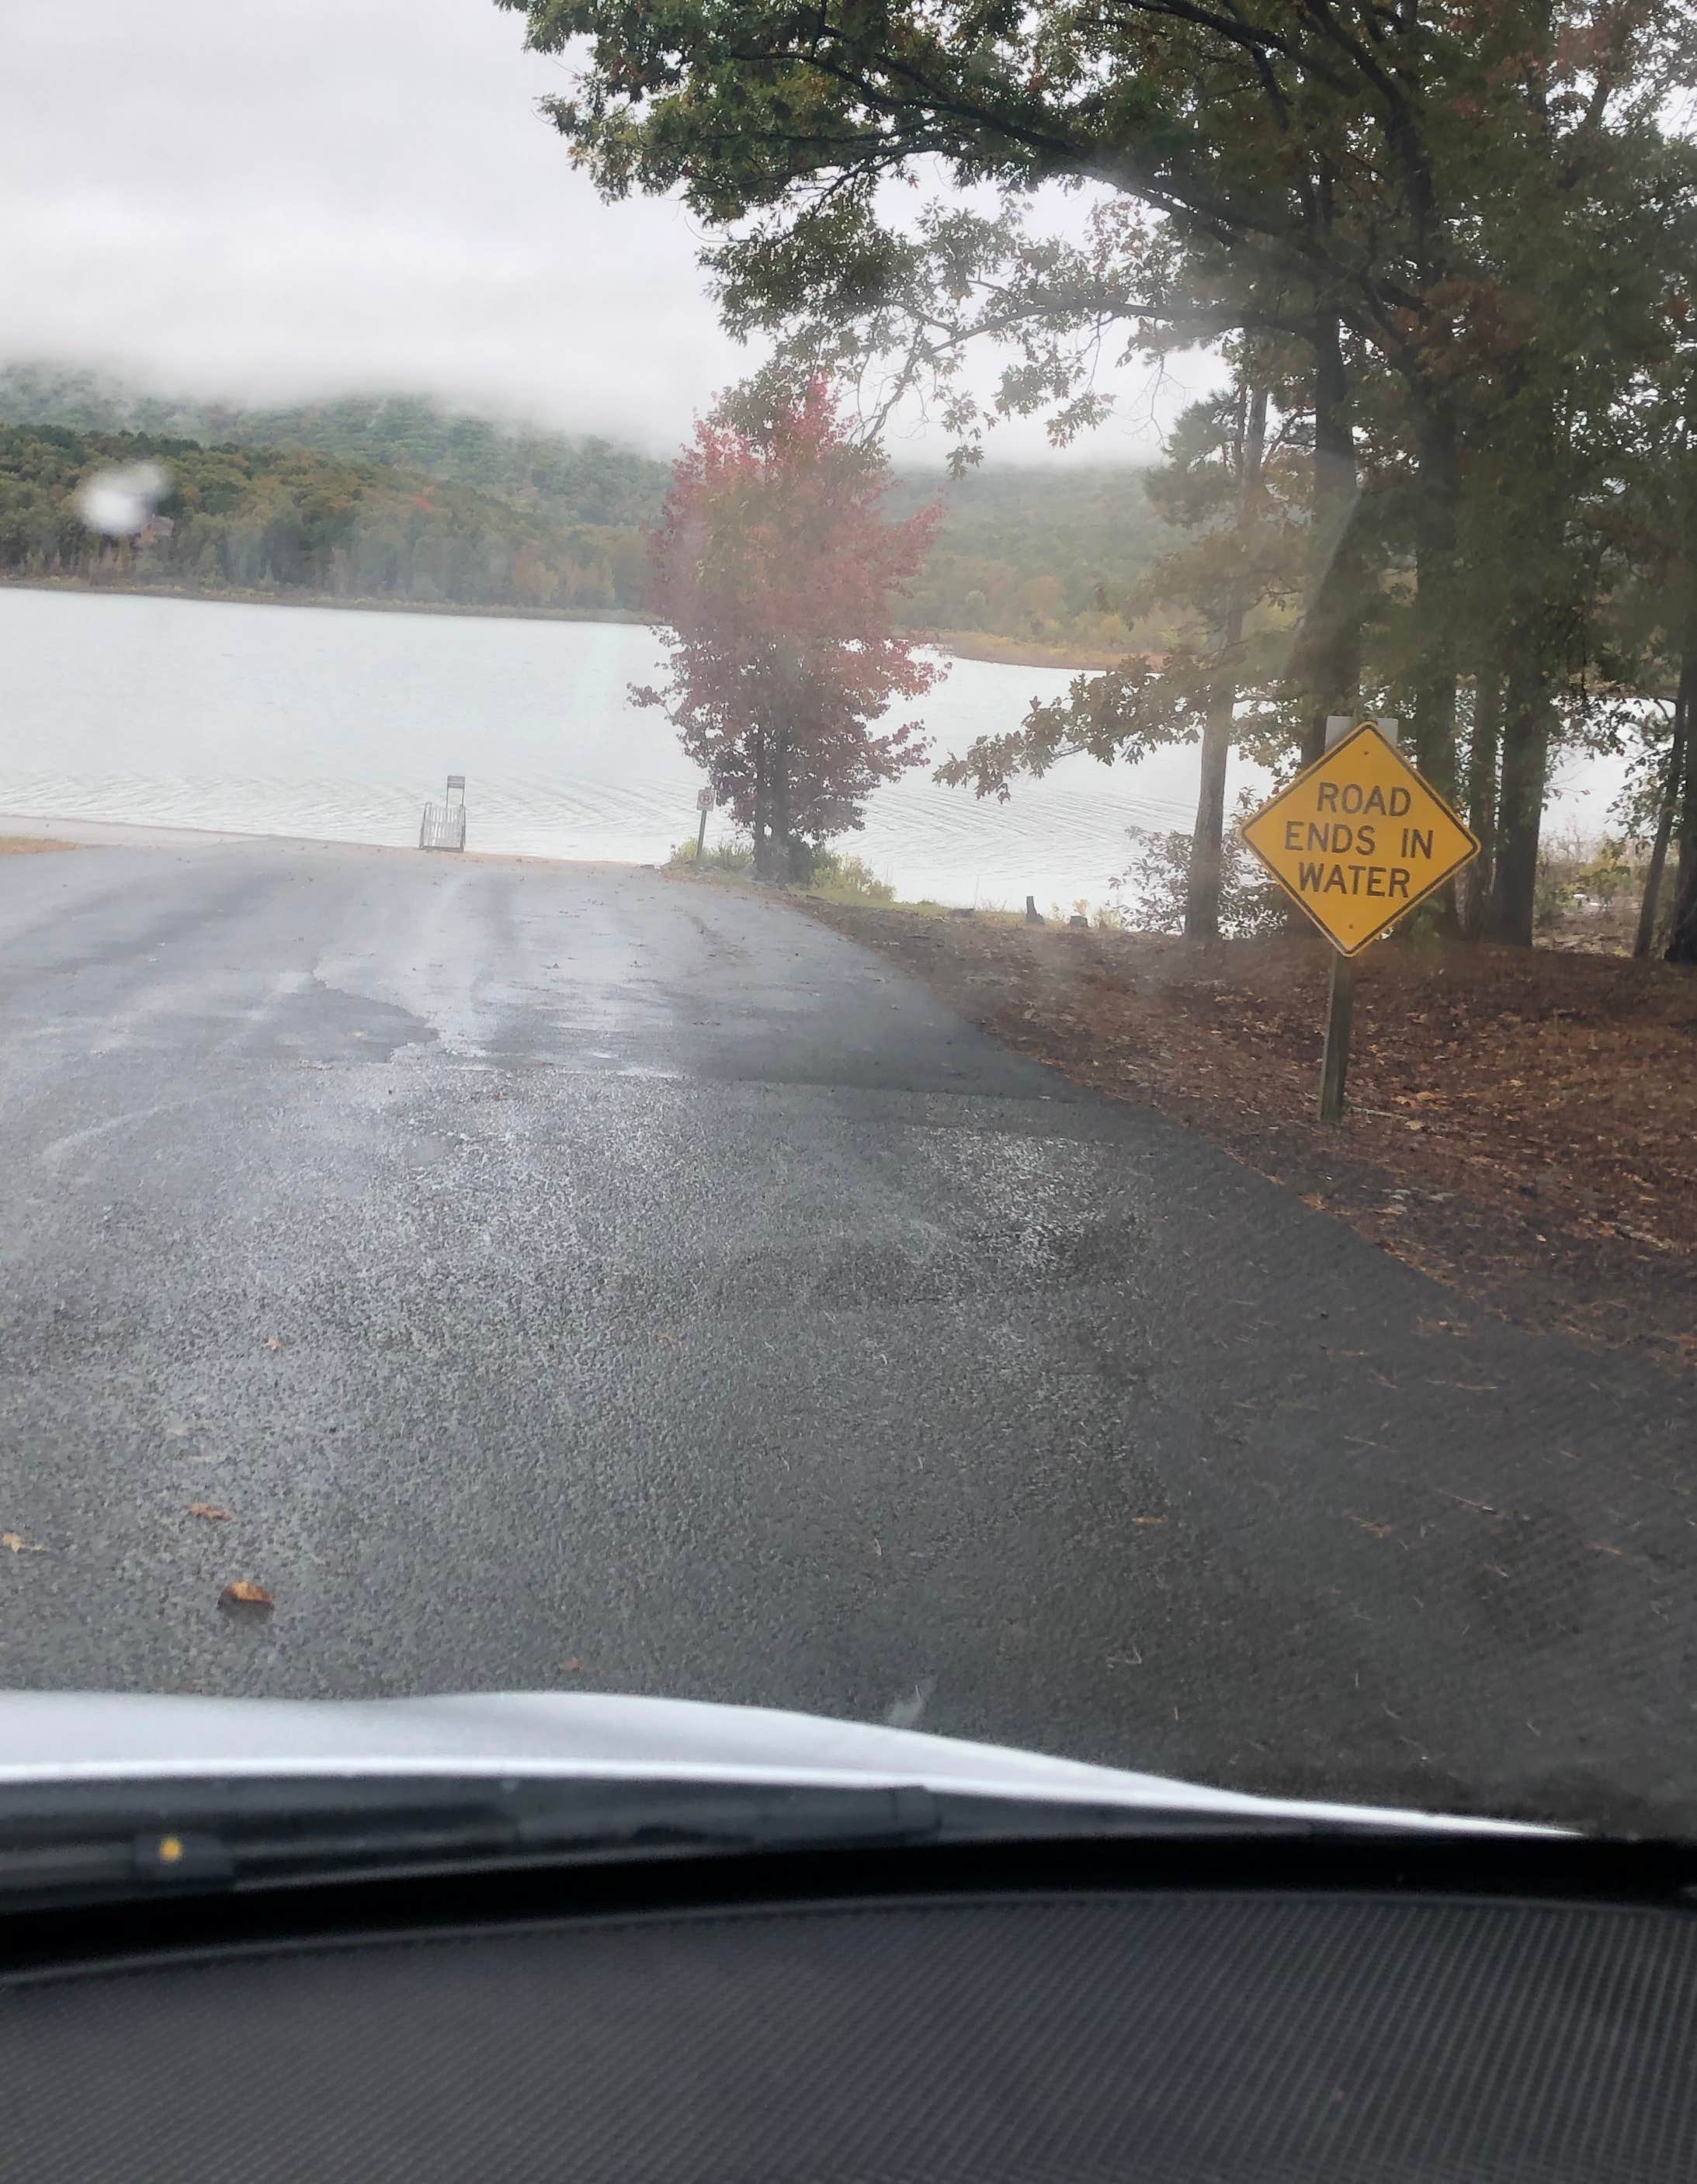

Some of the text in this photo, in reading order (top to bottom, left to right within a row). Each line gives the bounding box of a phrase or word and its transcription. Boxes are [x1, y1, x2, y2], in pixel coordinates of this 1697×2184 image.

[1317, 782, 1411, 816] ROAD
[1284, 820, 1433, 859] ENDS IN
[1299, 861, 1410, 898] WATER
